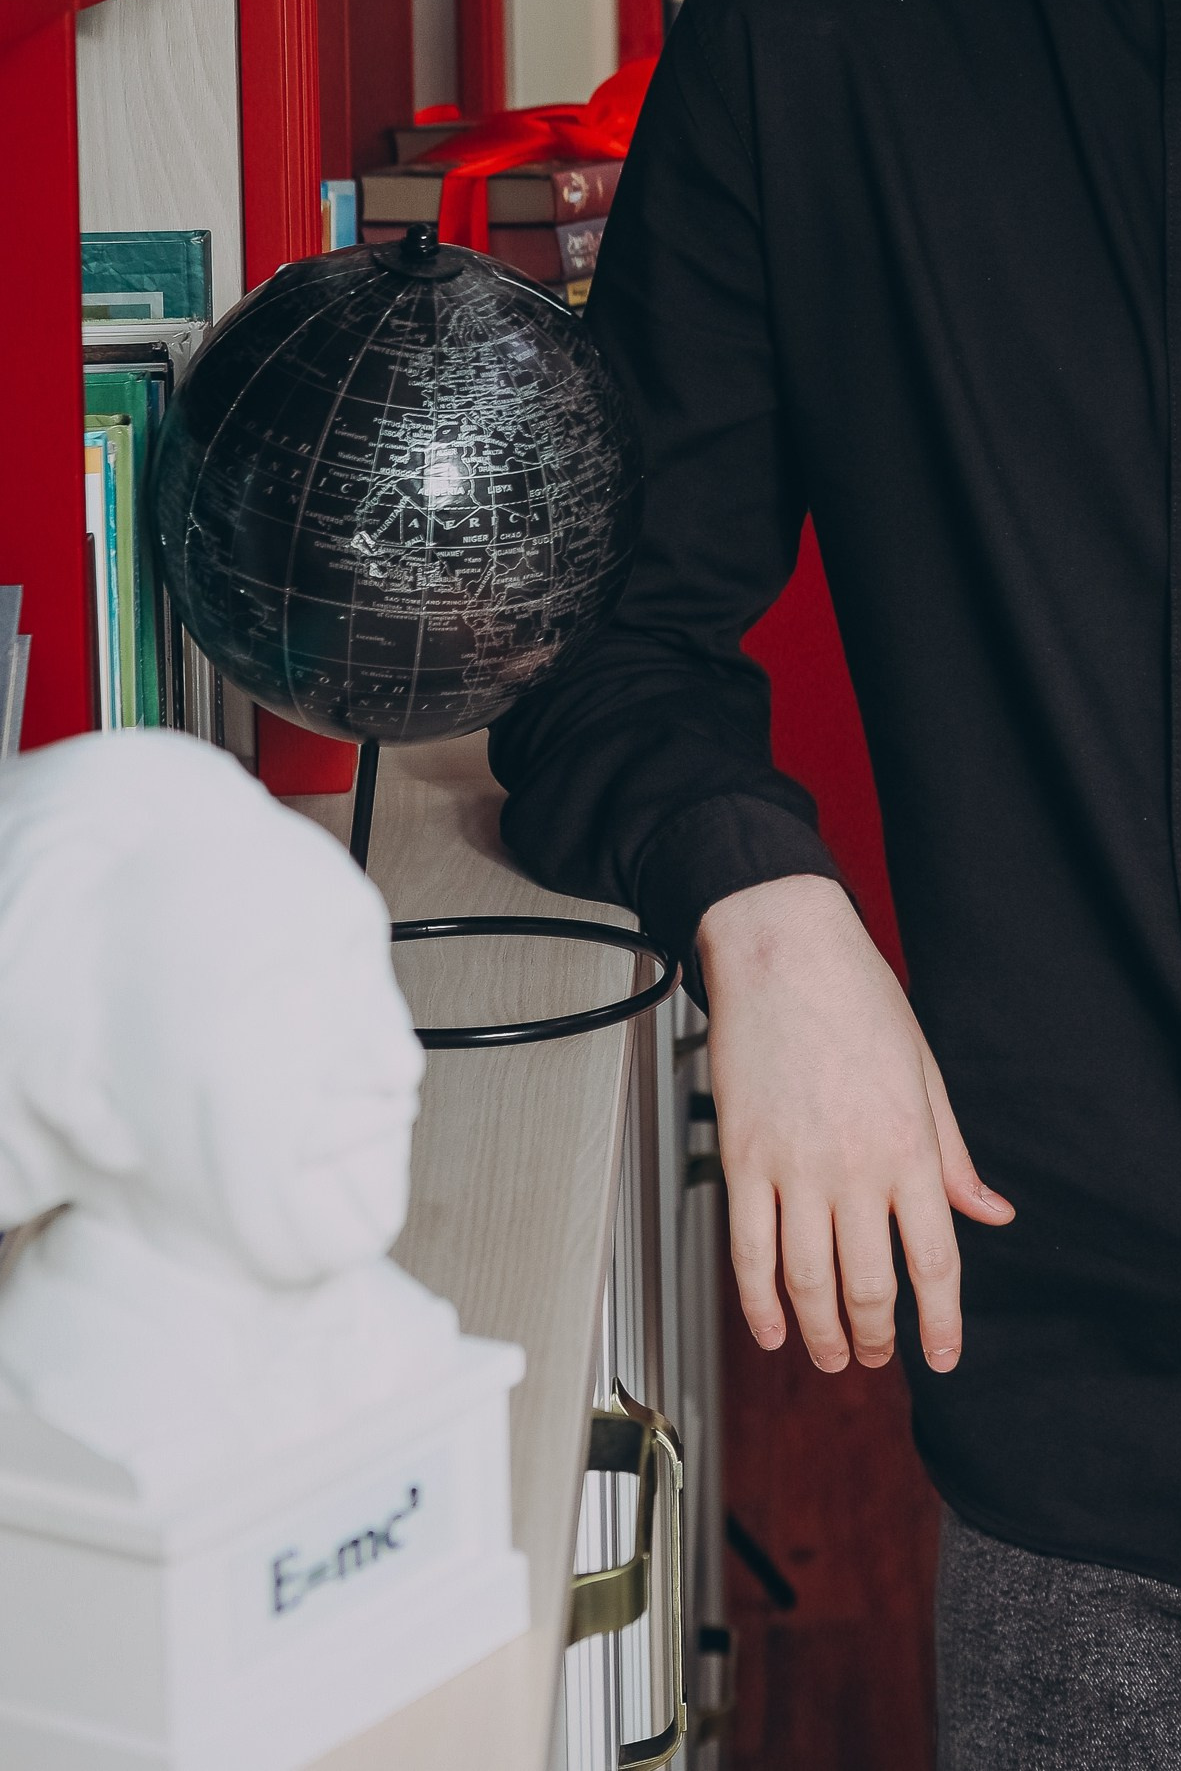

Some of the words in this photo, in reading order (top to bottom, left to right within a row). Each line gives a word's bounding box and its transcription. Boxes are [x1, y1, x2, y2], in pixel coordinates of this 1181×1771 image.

[487, 483, 513, 494] LIBYA
[463, 534, 490, 544] NIGER
[500, 532, 522, 541] CHAD
